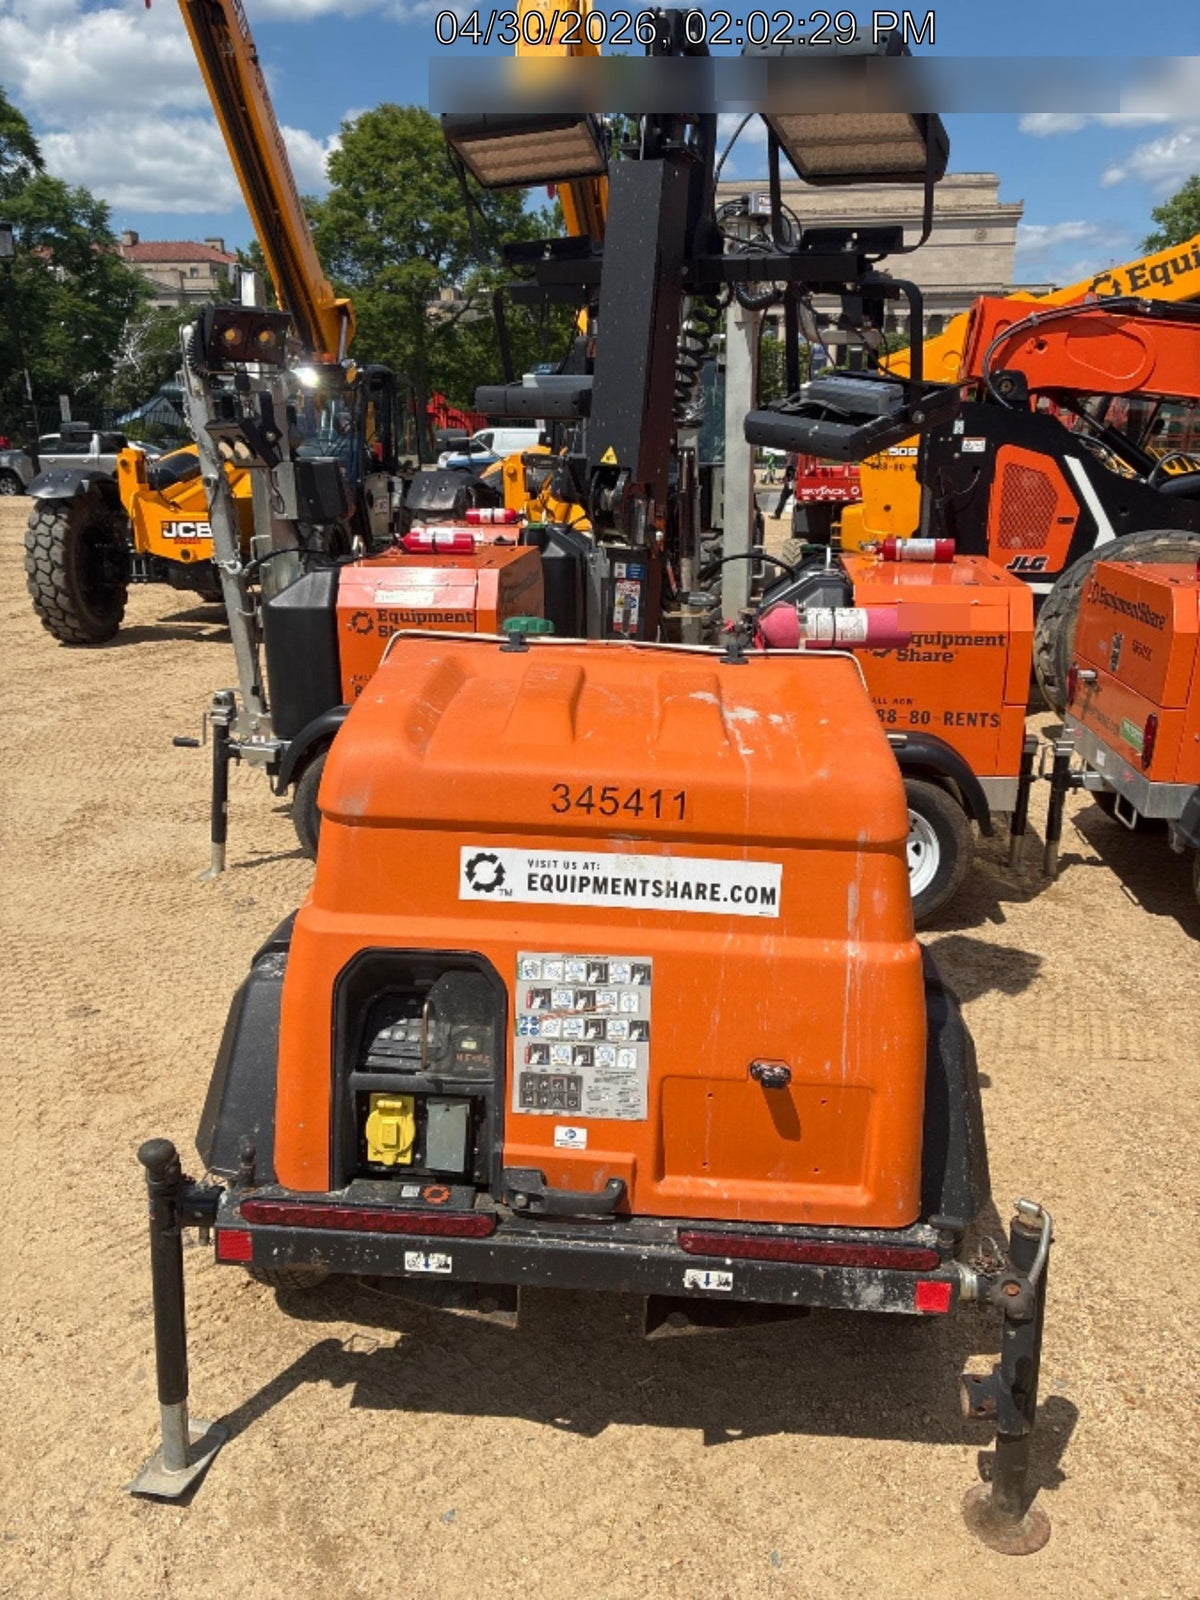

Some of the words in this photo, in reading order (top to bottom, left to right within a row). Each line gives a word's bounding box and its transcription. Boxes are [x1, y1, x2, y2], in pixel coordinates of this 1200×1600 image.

[801, 484, 847, 497] SKYJACK
[162, 522, 213, 538] JCB
[1005, 555, 1048, 571] JLG
[377, 609, 474, 626] Equipment
[911, 631, 1006, 649] quipment
[897, 649, 953, 662] Share
[551, 783, 687, 820] 345411
[527, 858, 558, 869] VISIT
[563, 861, 577, 870] US
[583, 861, 600, 871] AT:
[527, 873, 777, 906] EQUIPMENTSHARE.COM
